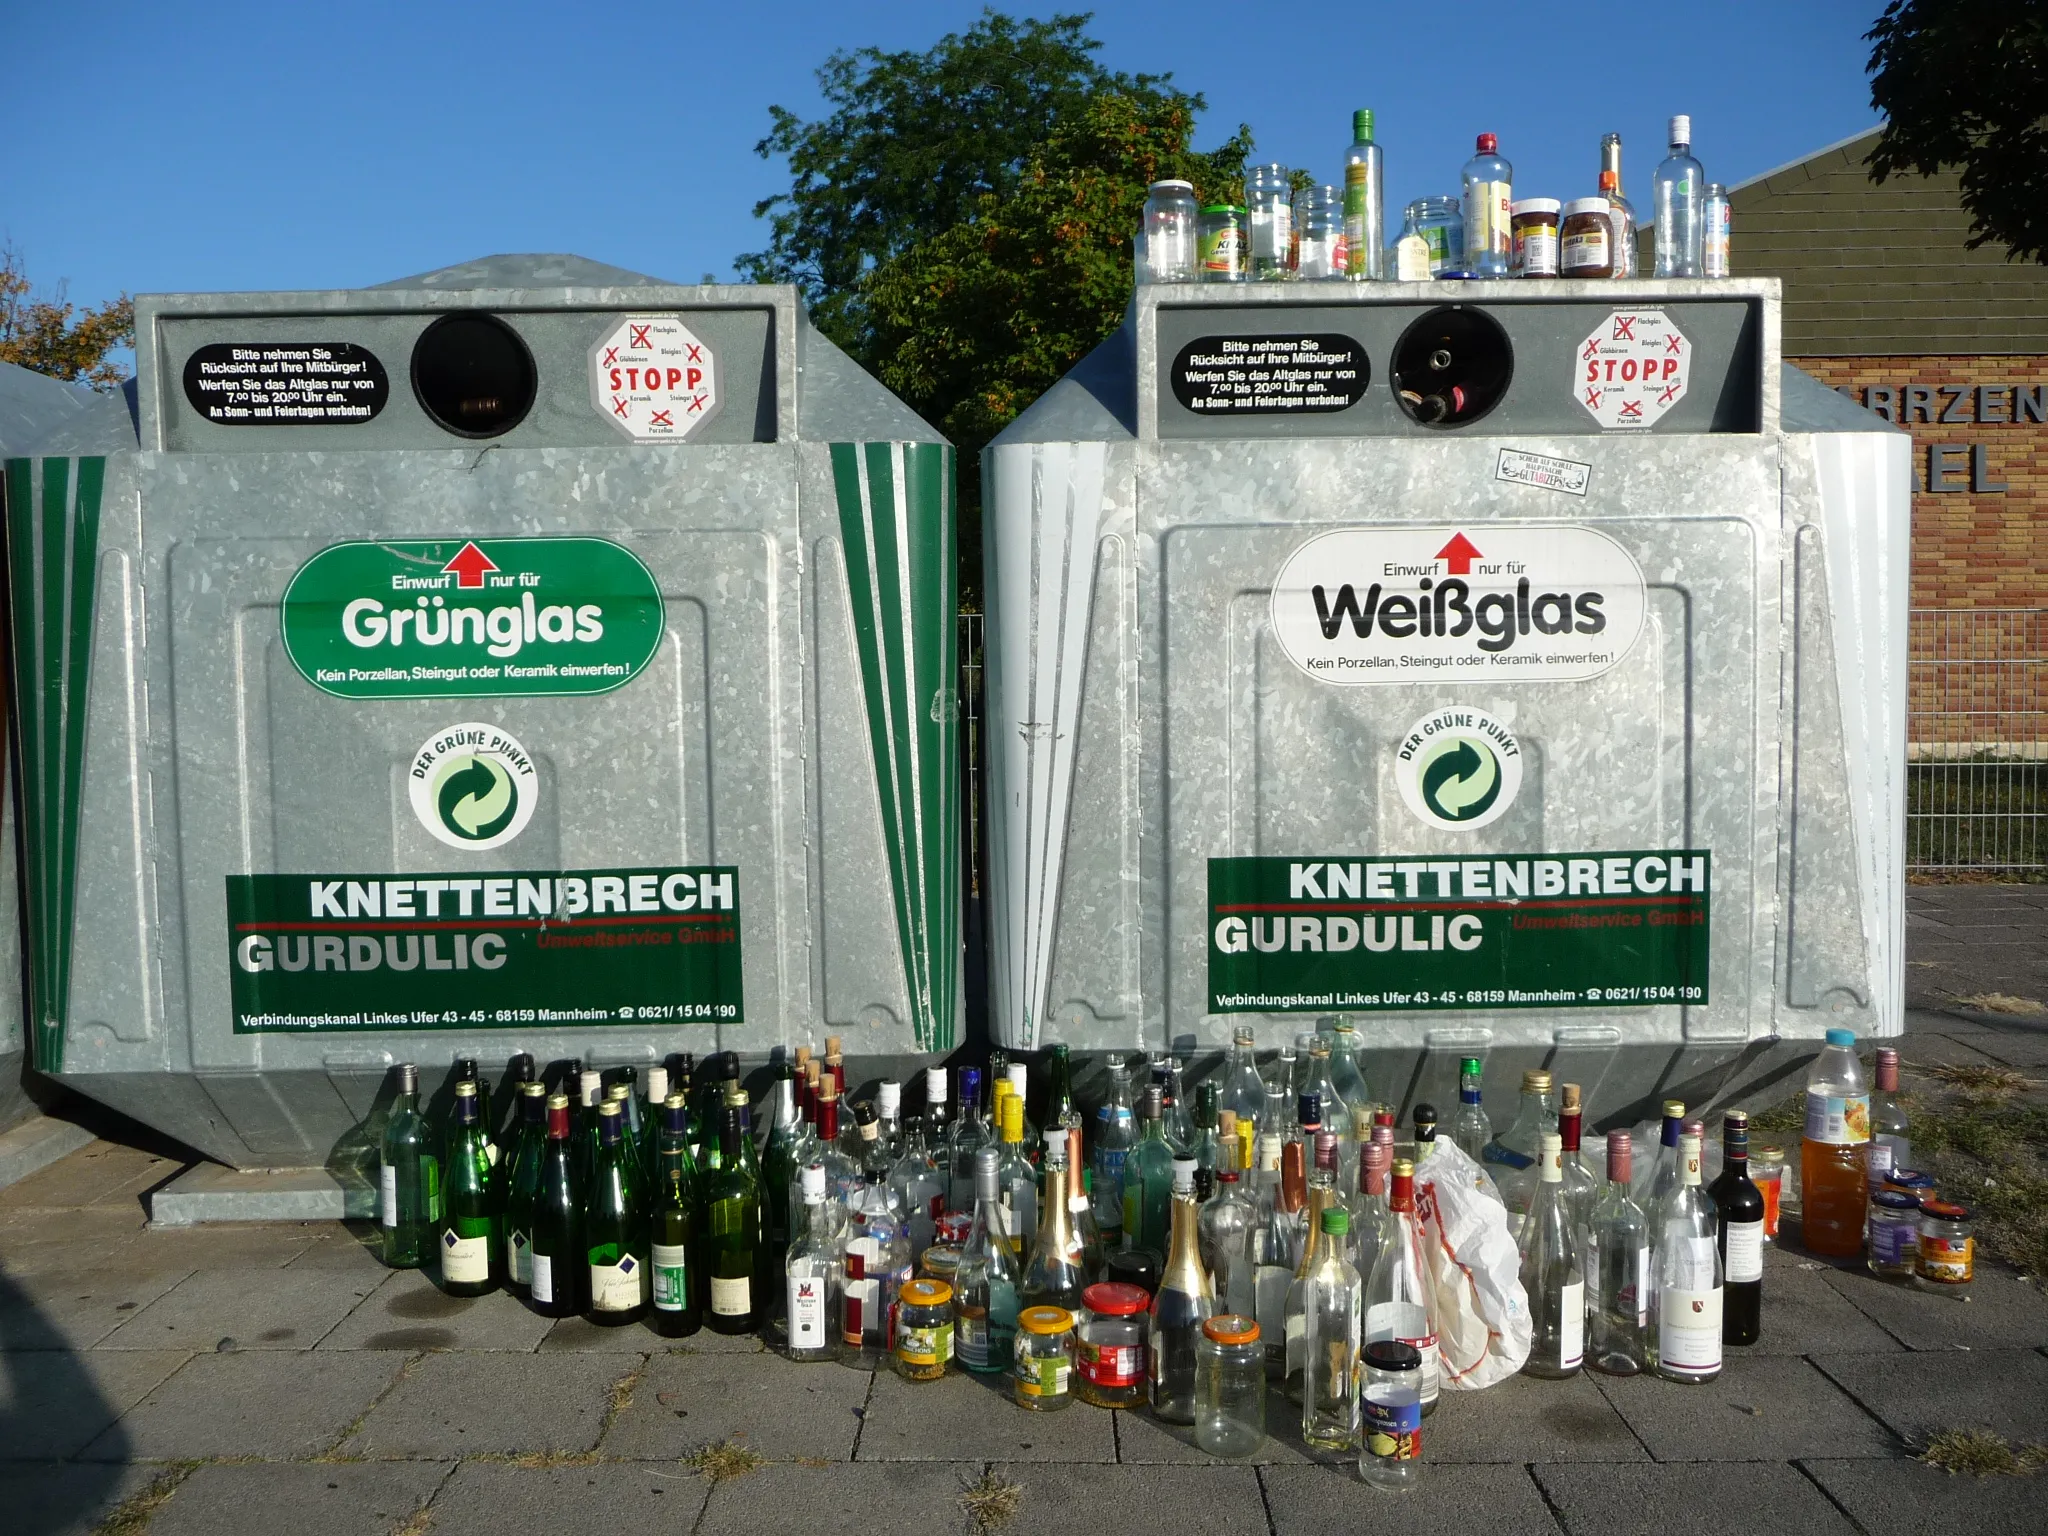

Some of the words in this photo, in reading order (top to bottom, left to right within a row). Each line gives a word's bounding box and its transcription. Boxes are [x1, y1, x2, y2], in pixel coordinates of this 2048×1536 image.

[653, 326, 677, 334] Flachglas
[1638, 318, 1661, 326] Flachglas
[232, 350, 260, 360] Bitte
[264, 350, 310, 359] nehmen
[313, 349, 331, 359] Sie
[661, 348, 681, 356] Bleiglas
[1223, 342, 1249, 352] Bitte
[1253, 341, 1297, 351] nehmen
[1301, 340, 1318, 350] Sie
[201, 362, 257, 374] Rücksicht
[260, 362, 278, 373] auf
[281, 362, 303, 372] Ihre
[306, 361, 366, 375] Mitbürger!
[1190, 354, 1244, 366] Rücksicht
[1247, 353, 1265, 364] auf
[1268, 353, 1289, 364] Ihre
[1292, 352, 1351, 365] Mitbürger!
[610, 368, 702, 390] STOPP
[1186, 371, 1224, 382] Werfen
[1228, 371, 1245, 381] Sie
[1249, 370, 1269, 380] das
[1273, 370, 1311, 381] Altglas
[1314, 370, 1332, 379] nur
[1336, 370, 1355, 378] von
[1587, 359, 1678, 382] STOPP
[198, 380, 239, 391] Werfen
[243, 379, 261, 390] Sie
[265, 379, 285, 390] das
[290, 379, 328, 391] Altglas
[332, 380, 349, 389] nur
[353, 380, 374, 389] von
[1234, 383, 1251, 393] bis
[1284, 382, 1304, 392] Uhr
[1307, 381, 1327, 392] ein.
[252, 392, 269, 403] bis
[303, 392, 323, 402] Uhr
[326, 392, 347, 402] ein.
[1192, 398, 1203, 408] An
[1206, 397, 1232, 407] Sonn-
[1235, 397, 1252, 406] und
[1255, 396, 1303, 407] Feiertagen
[1306, 394, 1349, 405] verboten!
[210, 407, 222, 416] An
[225, 407, 252, 416] Sonn-
[255, 406, 272, 416] und
[275, 406, 324, 417] Feiertagen
[327, 405, 371, 416] verboten!
[1911, 444, 2008, 492] EL
[1384, 563, 1439, 577] Einwurf
[1479, 564, 1502, 574] nur
[1507, 562, 1526, 574] für
[392, 574, 450, 590] Einwurf
[491, 575, 515, 588] nur
[519, 573, 541, 587] für
[1312, 577, 1606, 652] Weißglas
[342, 591, 604, 657] Grünglas
[1307, 658, 1334, 669] Kein
[1338, 656, 1398, 670] Porzellan,
[1400, 654, 1453, 670] Steingut
[1456, 654, 1485, 666] oder
[1490, 653, 1542, 665] Keramik
[1546, 652, 1614, 665] einwerfen!
[317, 669, 345, 682] Kein
[349, 667, 410, 682] Porzellan,
[412, 666, 467, 681] Steingut
[470, 666, 500, 678] oder
[504, 664, 557, 678] Keramik
[561, 663, 630, 677] einwerfen!
[1400, 733, 1424, 761] DER
[1424, 712, 1473, 735] GRÜNE
[1478, 718, 1519, 757] PUNKT
[412, 751, 435, 779] DER
[435, 729, 486, 753] GRÜNE
[490, 736, 533, 776] PUNKT
[1290, 857, 1704, 899] KNETTENBRECH
[310, 873, 733, 918] KNETTENBRECH
[1513, 912, 1642, 930] Umweltservice
[1647, 909, 1704, 926] GmbH
[537, 930, 672, 949] Umweltservice
[678, 927, 735, 944] GmbH
[1214, 914, 1482, 954] GURDULIC
[237, 932, 507, 973] GURDULIC
[1216, 992, 1333, 1008] Verbindungskanal
[1337, 992, 1379, 1004] Linkes
[1383, 992, 1411, 1003] Ufer
[1414, 992, 1429, 1003] 43
[1440, 991, 1455, 1002] 45
[1467, 991, 1504, 1002] 68159
[1509, 989, 1575, 1001] Mannheim
[1606, 987, 1640, 999] 0621/
[1643, 987, 1657, 998] 15
[1660, 986, 1675, 998] 04
[1679, 986, 1701, 998] 190
[241, 1012, 360, 1028] Verbindungskanal
[364, 1012, 407, 1024] Linkes
[411, 1011, 439, 1023] Ufer
[442, 1011, 457, 1023] 43
[469, 1011, 485, 1022] 45
[496, 1010, 534, 1021] 68159
[539, 1008, 608, 1021] Mannheim
[638, 1006, 673, 1018] 0621/
[677, 1005, 692, 1017] 15
[695, 1005, 711, 1017] 04
[714, 1005, 736, 1017] 190
